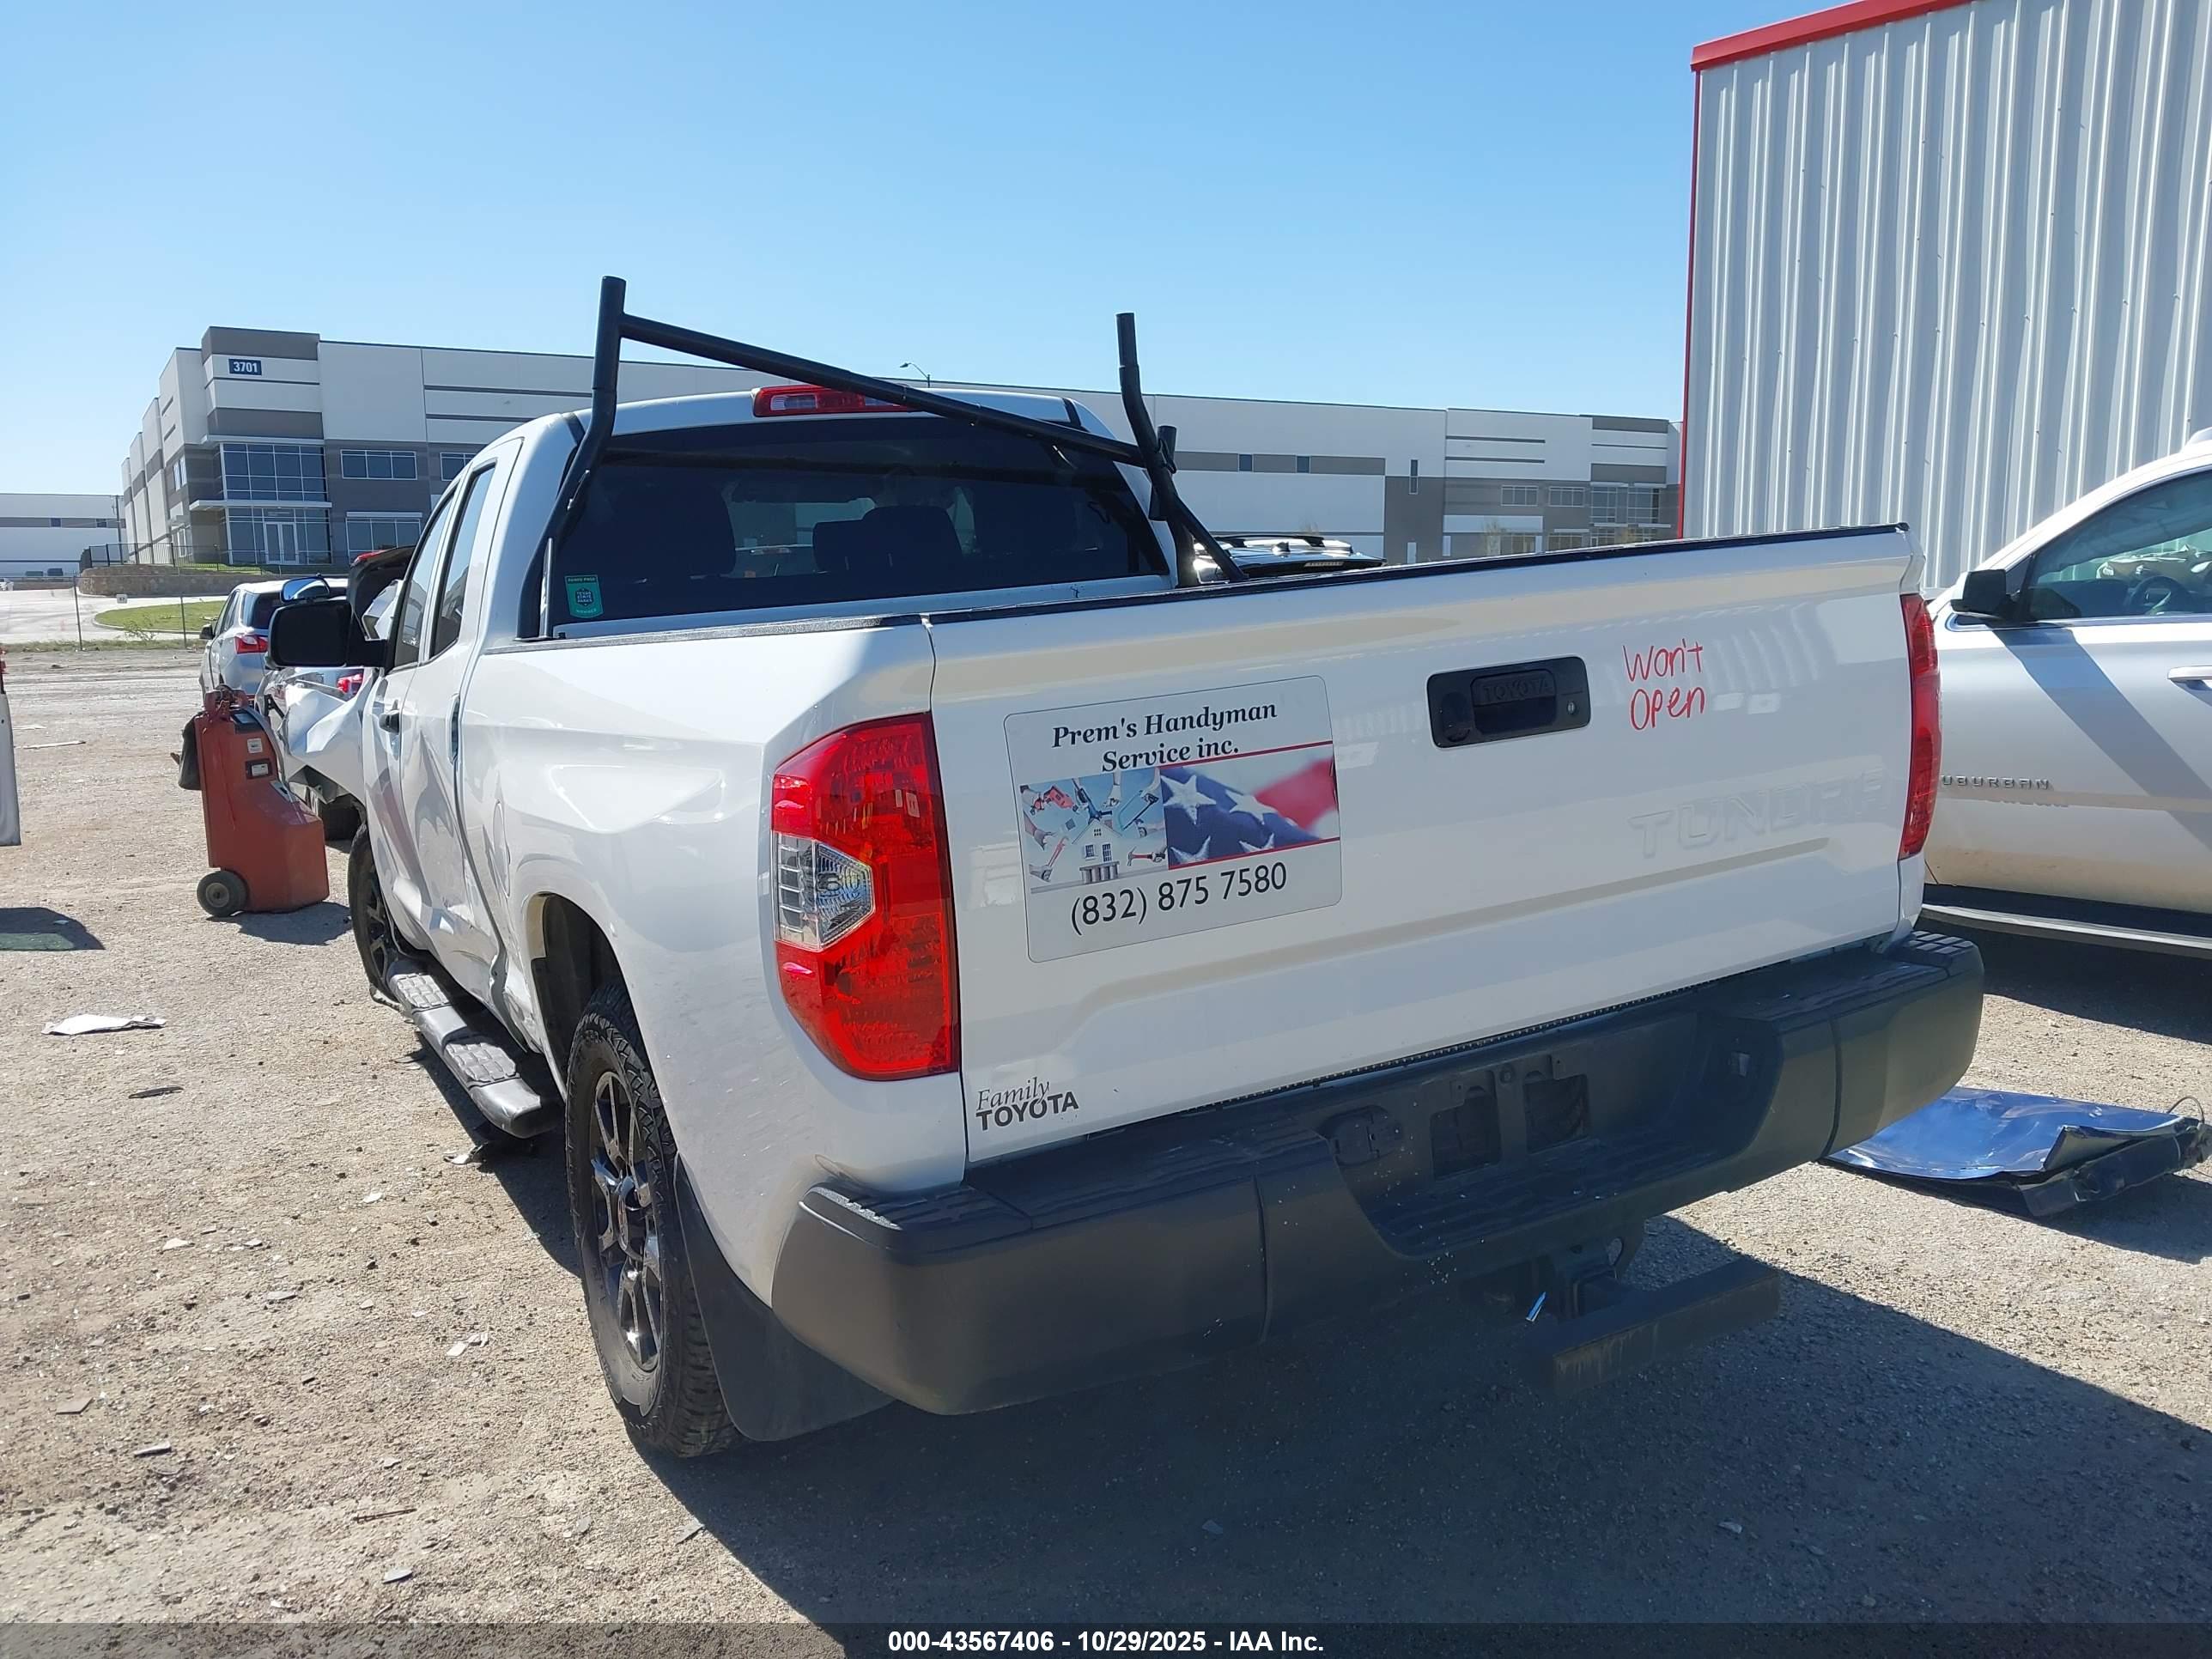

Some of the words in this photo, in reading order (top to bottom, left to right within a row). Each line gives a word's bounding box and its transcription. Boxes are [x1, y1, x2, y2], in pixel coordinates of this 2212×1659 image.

[233, 362, 258, 373] 3701
[1622, 638, 1704, 682] Won't
[1052, 717, 1138, 748] Prem's
[1144, 703, 1278, 736] Handyman
[1630, 687, 1705, 731] Open
[1102, 743, 1191, 773] Service
[1197, 737, 1239, 758] inc.
[1941, 775, 2051, 790] UBURBAN
[1071, 886, 1148, 936] (832)
[1158, 875, 1210, 911] 875
[1220, 861, 1287, 901] 7580
[975, 1091, 1079, 1131] TOYOTA
[976, 1076, 1049, 1111] Family
